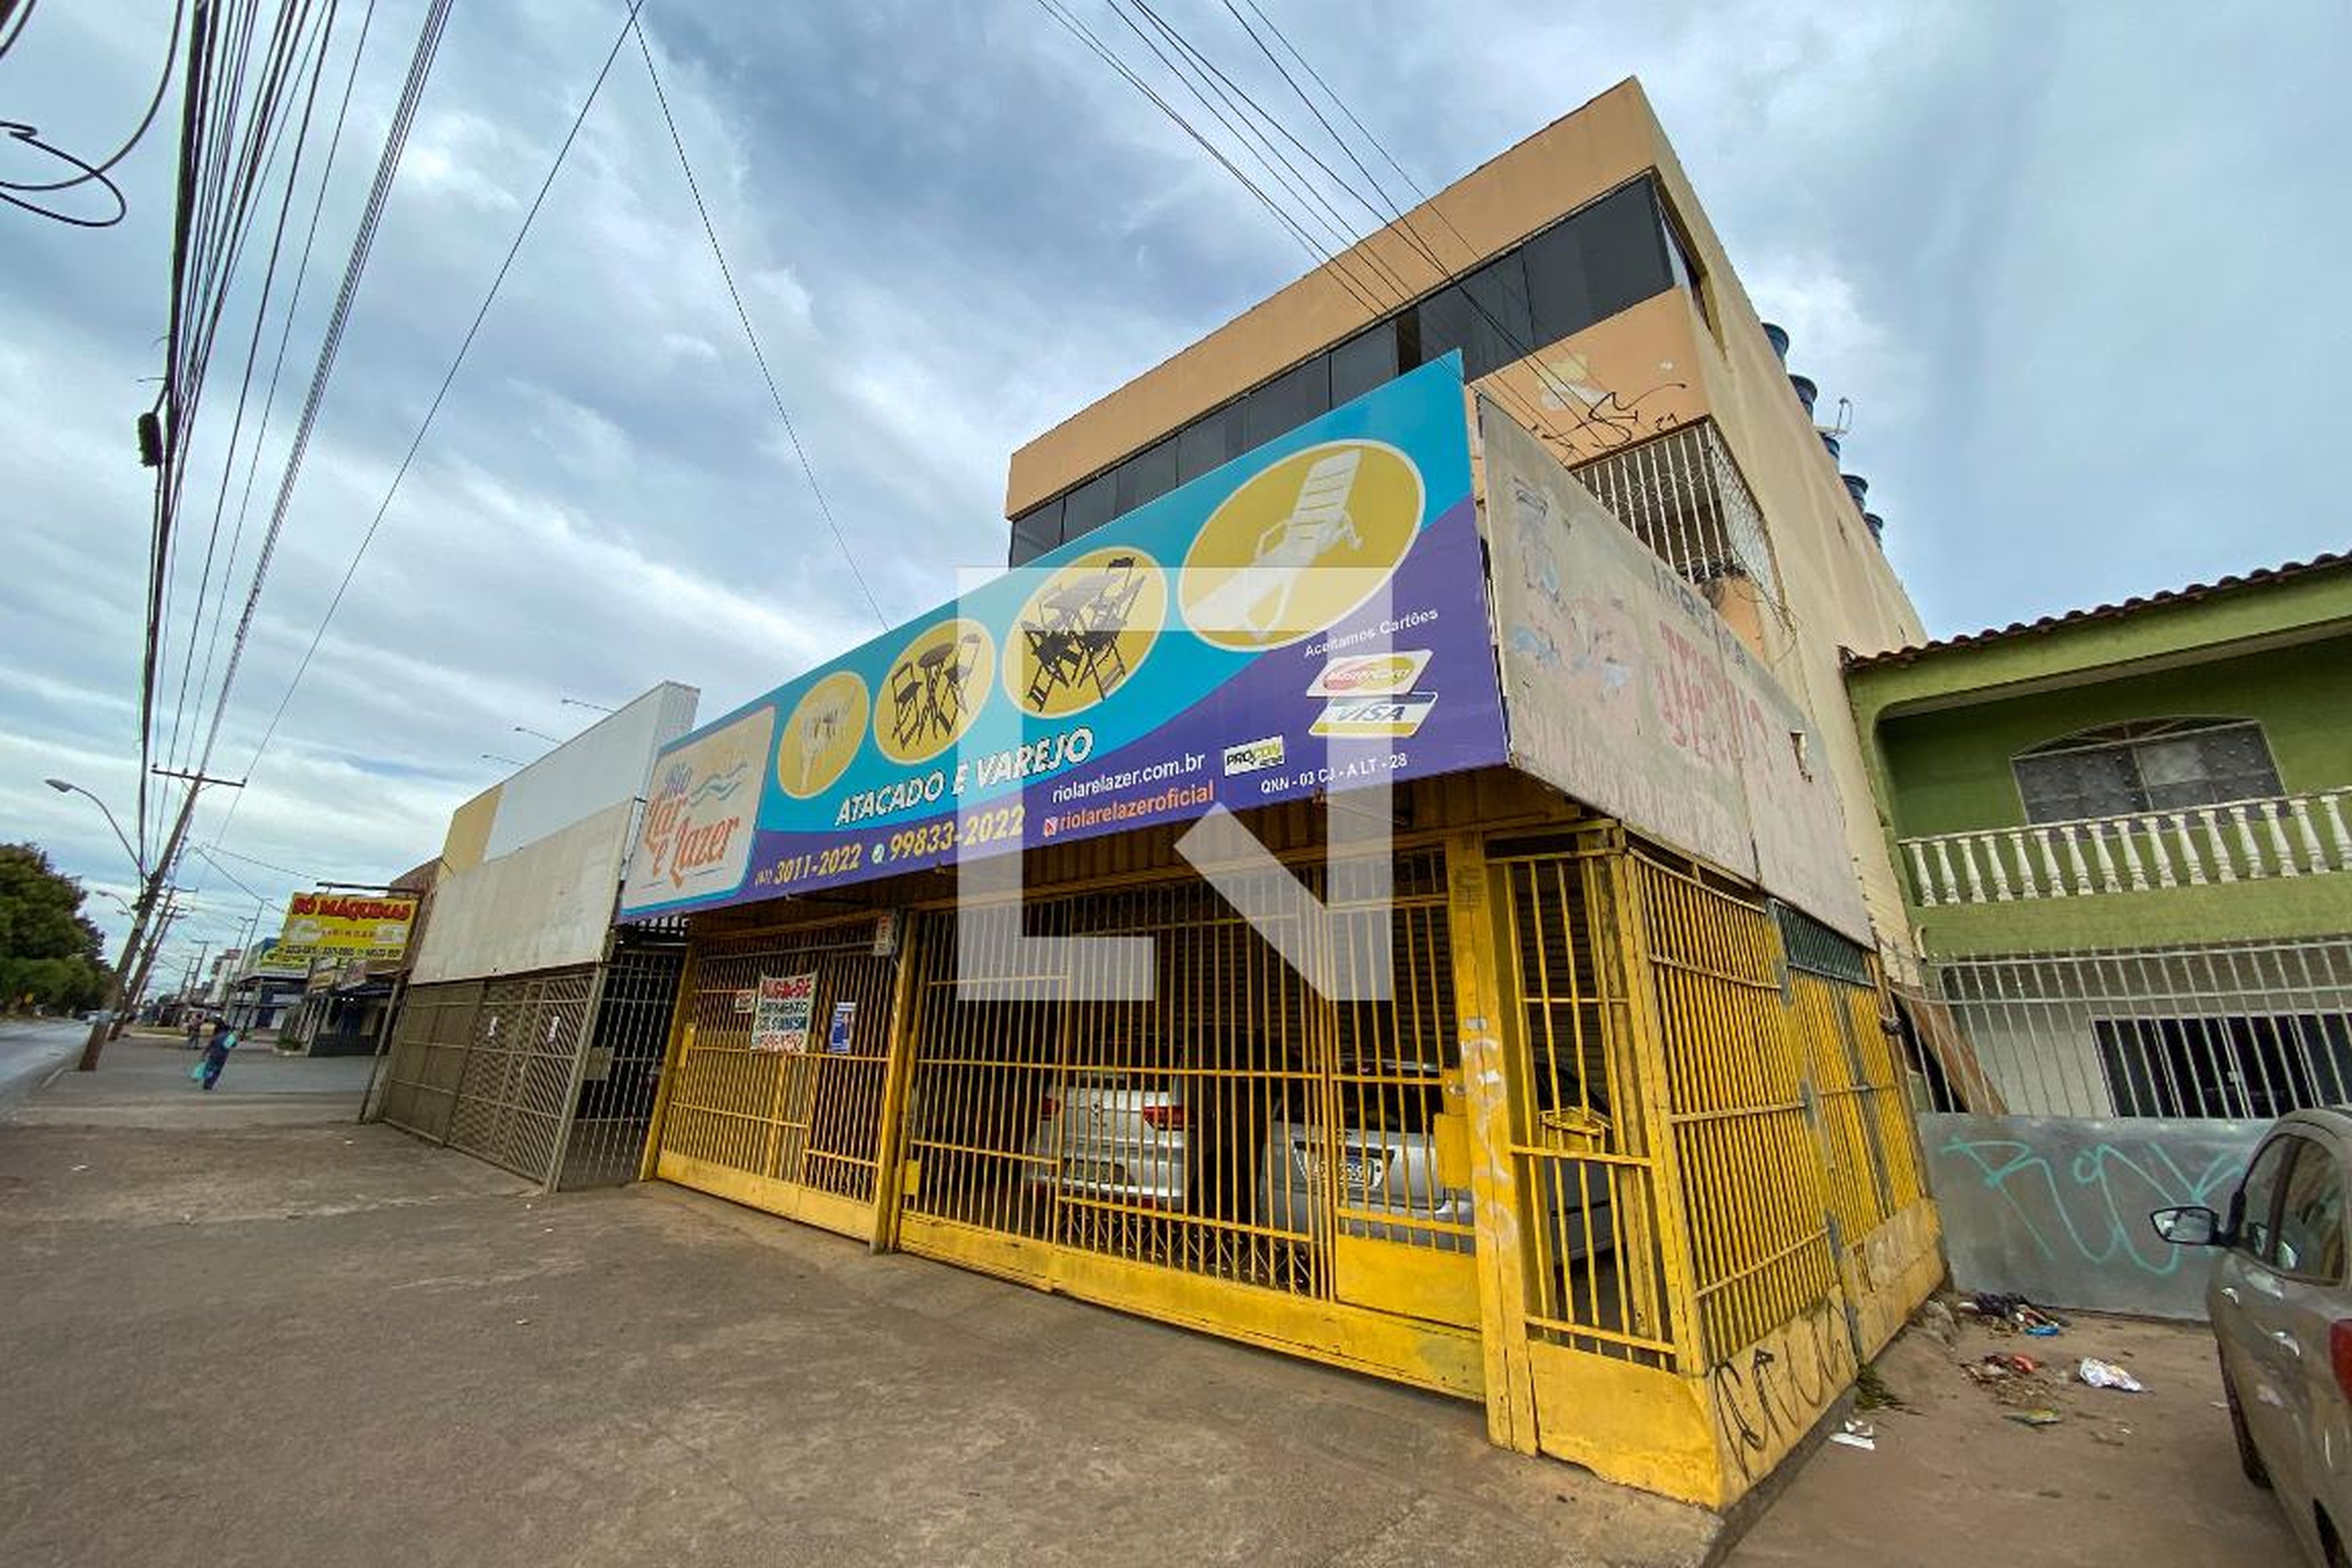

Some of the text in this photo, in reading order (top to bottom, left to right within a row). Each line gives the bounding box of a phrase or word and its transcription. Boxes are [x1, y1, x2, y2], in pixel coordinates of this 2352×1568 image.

[1379, 609, 1438, 634] Cartões
[1336, 705, 1406, 722] VISA
[834, 726, 1094, 827] ATACADO E VAREJO
[1052, 753, 1205, 804] riolarelazer.com.br
[1300, 771, 1314, 786] 03
[1388, 752, 1408, 769] 28
[1061, 779, 1215, 831] riolarelazeroficial
[670, 815, 741, 889] Lazer
[773, 843, 862, 886] 3011-2022
[889, 803, 1026, 860] 99833-2022
